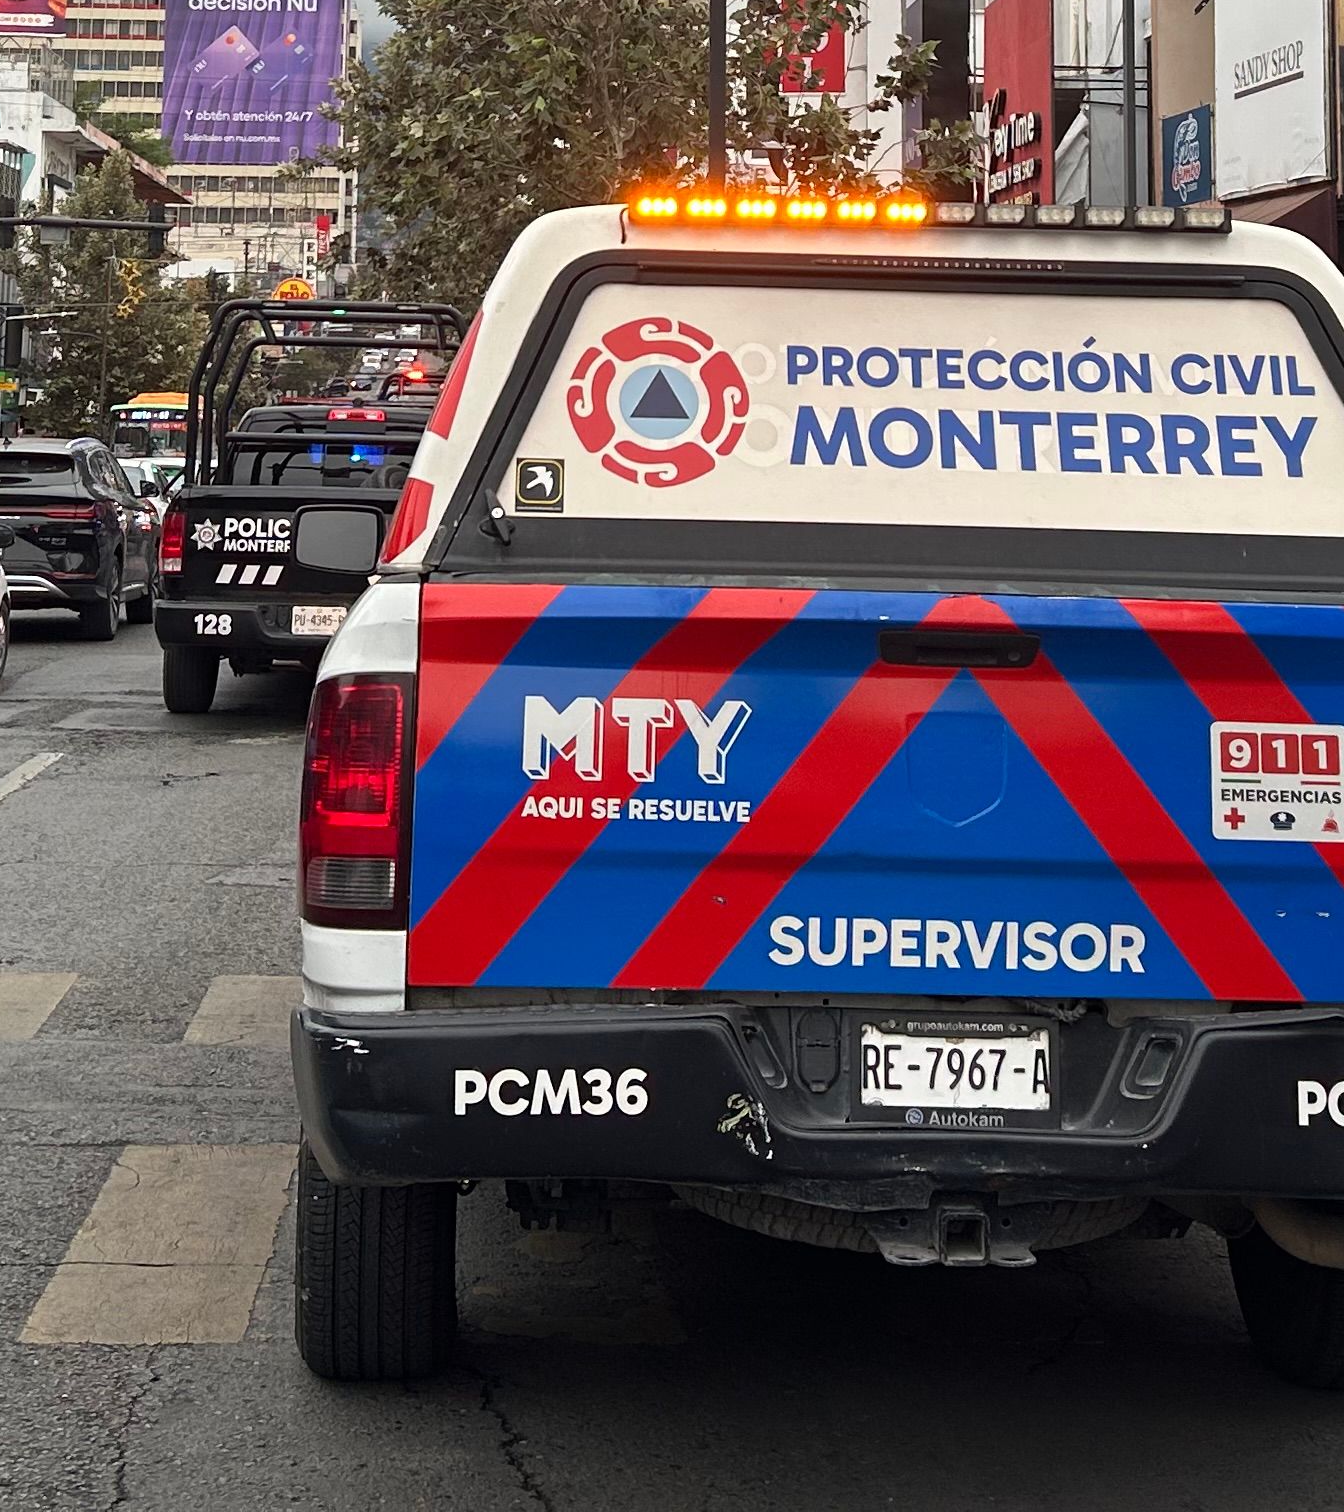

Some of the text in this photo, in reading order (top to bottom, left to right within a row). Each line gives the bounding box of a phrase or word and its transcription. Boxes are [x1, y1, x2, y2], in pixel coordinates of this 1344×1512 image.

[1233, 40, 1304, 89] SANDY SHOP
[184, 109, 313, 123] Y obtén atención 24/7
[787, 336, 1316, 396] PROTECCIÓN CIVIL
[788, 405, 1318, 477] MONTERREY
[193, 614, 233, 636] 128
[522, 695, 753, 785] MTY
[1227, 737, 1329, 771] 911
[520, 795, 752, 824] AQUI SE RESUELVE
[1220, 788, 1342, 805] EMERGENCIAS
[768, 915, 1147, 974] SUPERVISOR
[906, 1019, 1005, 1033] grupoautokam.com
[862, 1044, 1051, 1095] RE-7967-A
[454, 1068, 649, 1116] PCM36
[928, 1110, 1005, 1129] Autokam
